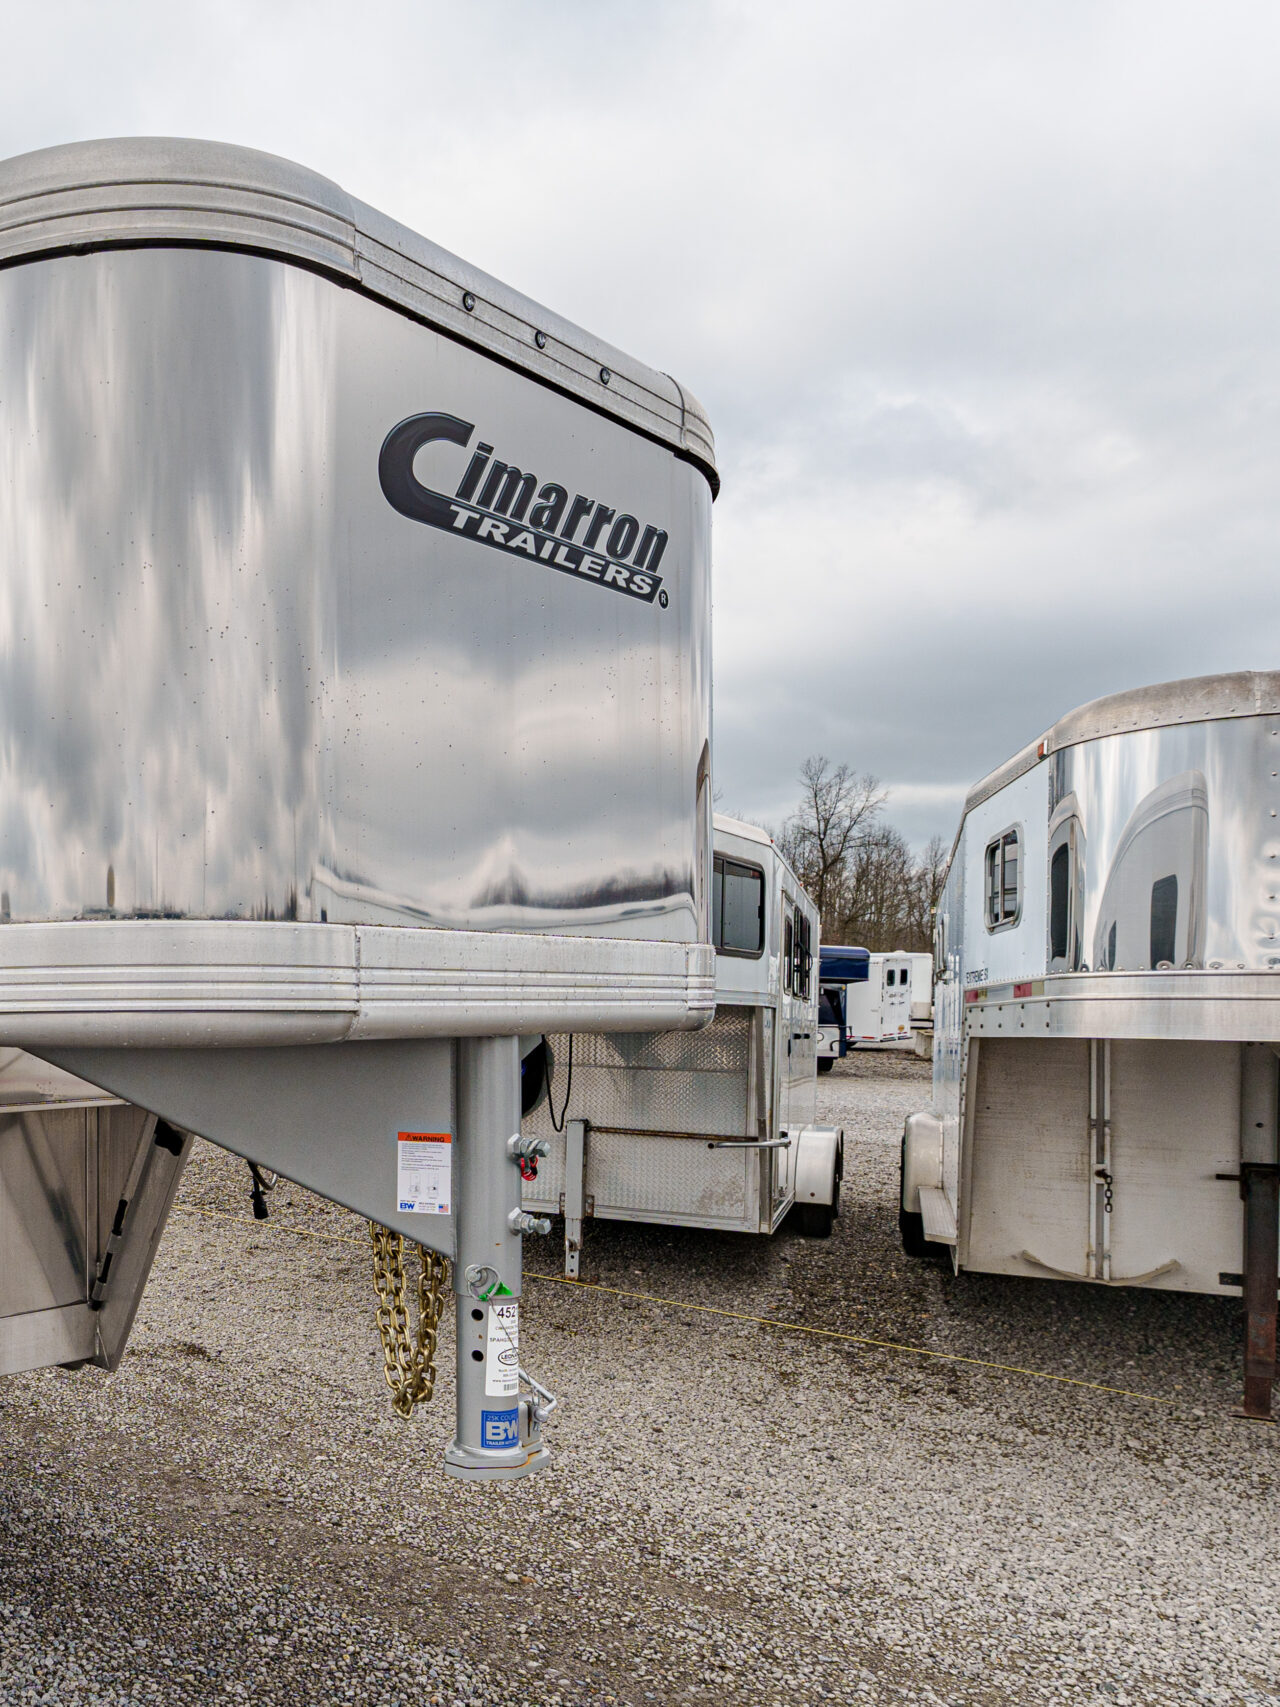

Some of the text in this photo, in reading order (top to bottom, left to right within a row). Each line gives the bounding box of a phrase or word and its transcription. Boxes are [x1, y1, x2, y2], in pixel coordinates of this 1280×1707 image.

[378, 411, 669, 574] Cimarron
[449, 504, 654, 595] TRAILERS
[411, 1135, 445, 1143] WARNING
